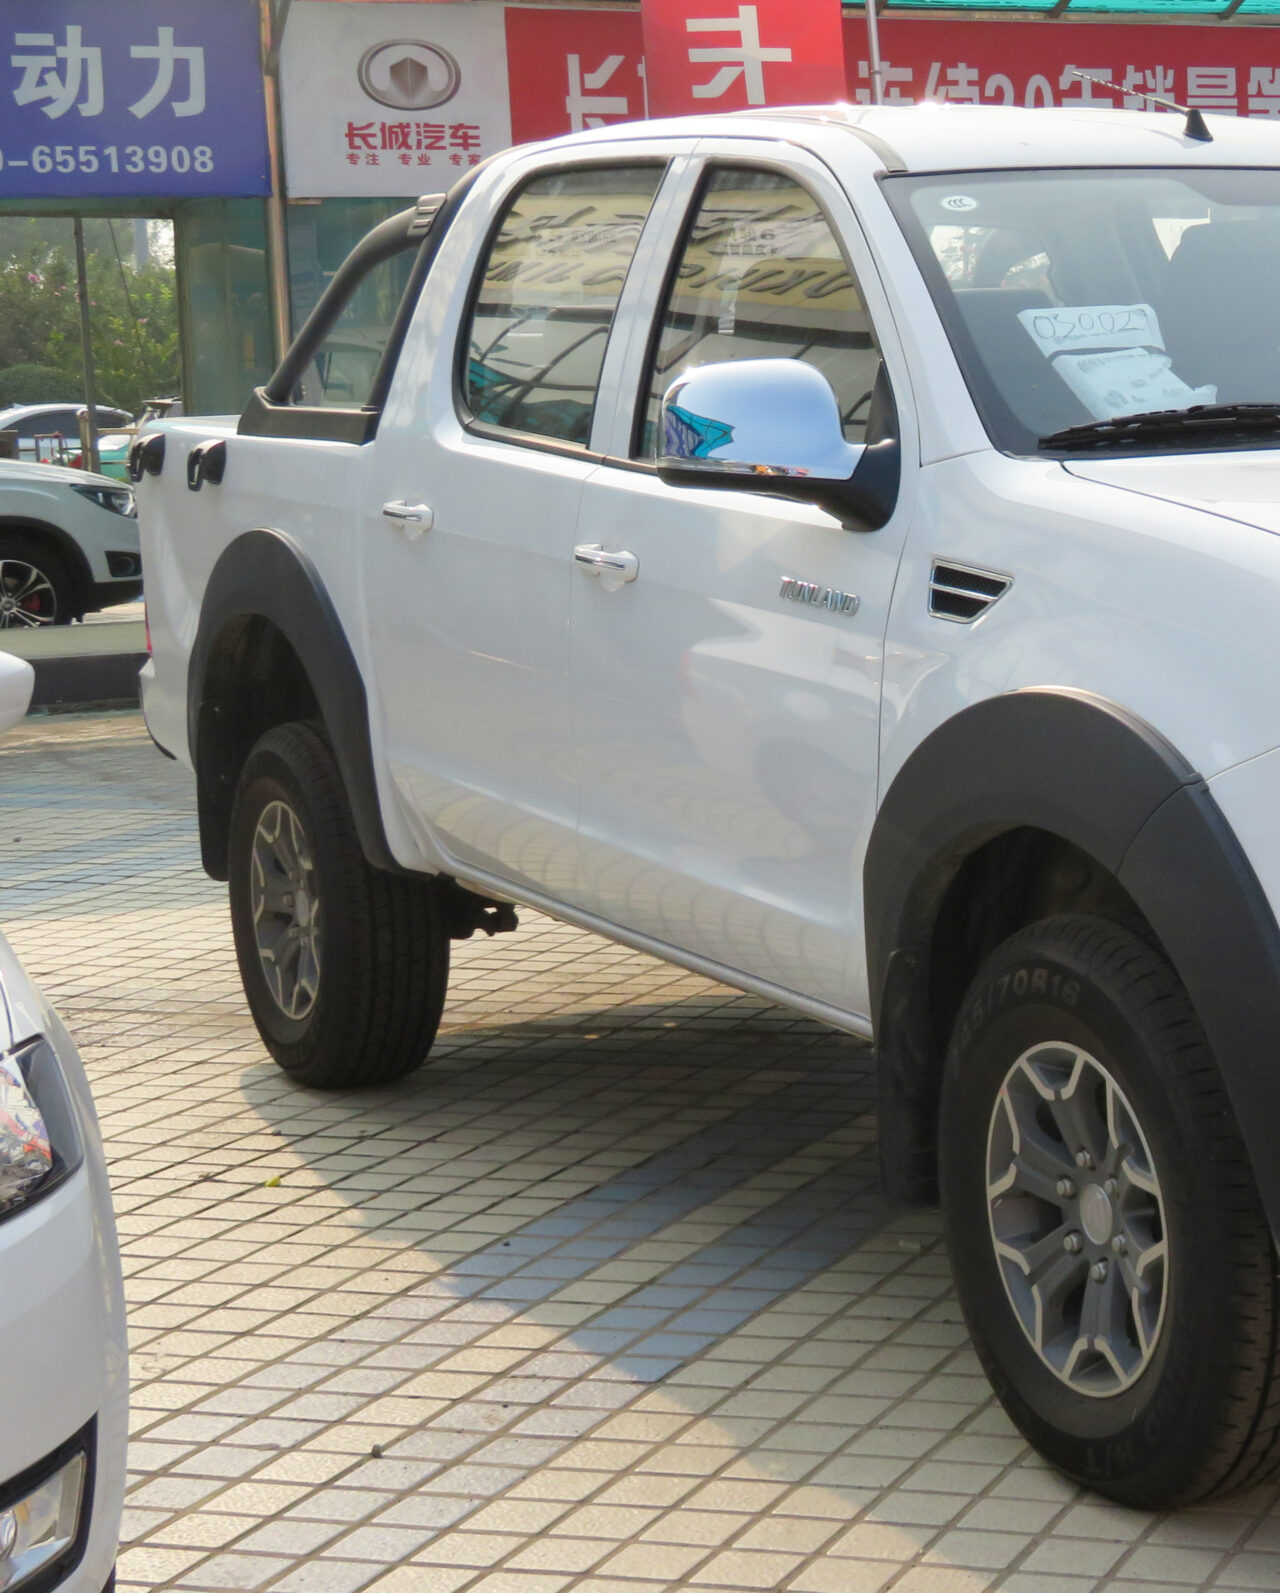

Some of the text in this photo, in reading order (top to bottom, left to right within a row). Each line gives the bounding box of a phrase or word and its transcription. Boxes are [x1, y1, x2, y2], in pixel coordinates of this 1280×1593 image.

[11, 25, 206, 119] 动力
[345, 122, 481, 150] 长城汽车
[0, 145, 214, 173] -65513908
[345, 153, 481, 166] 专注 专业 专家
